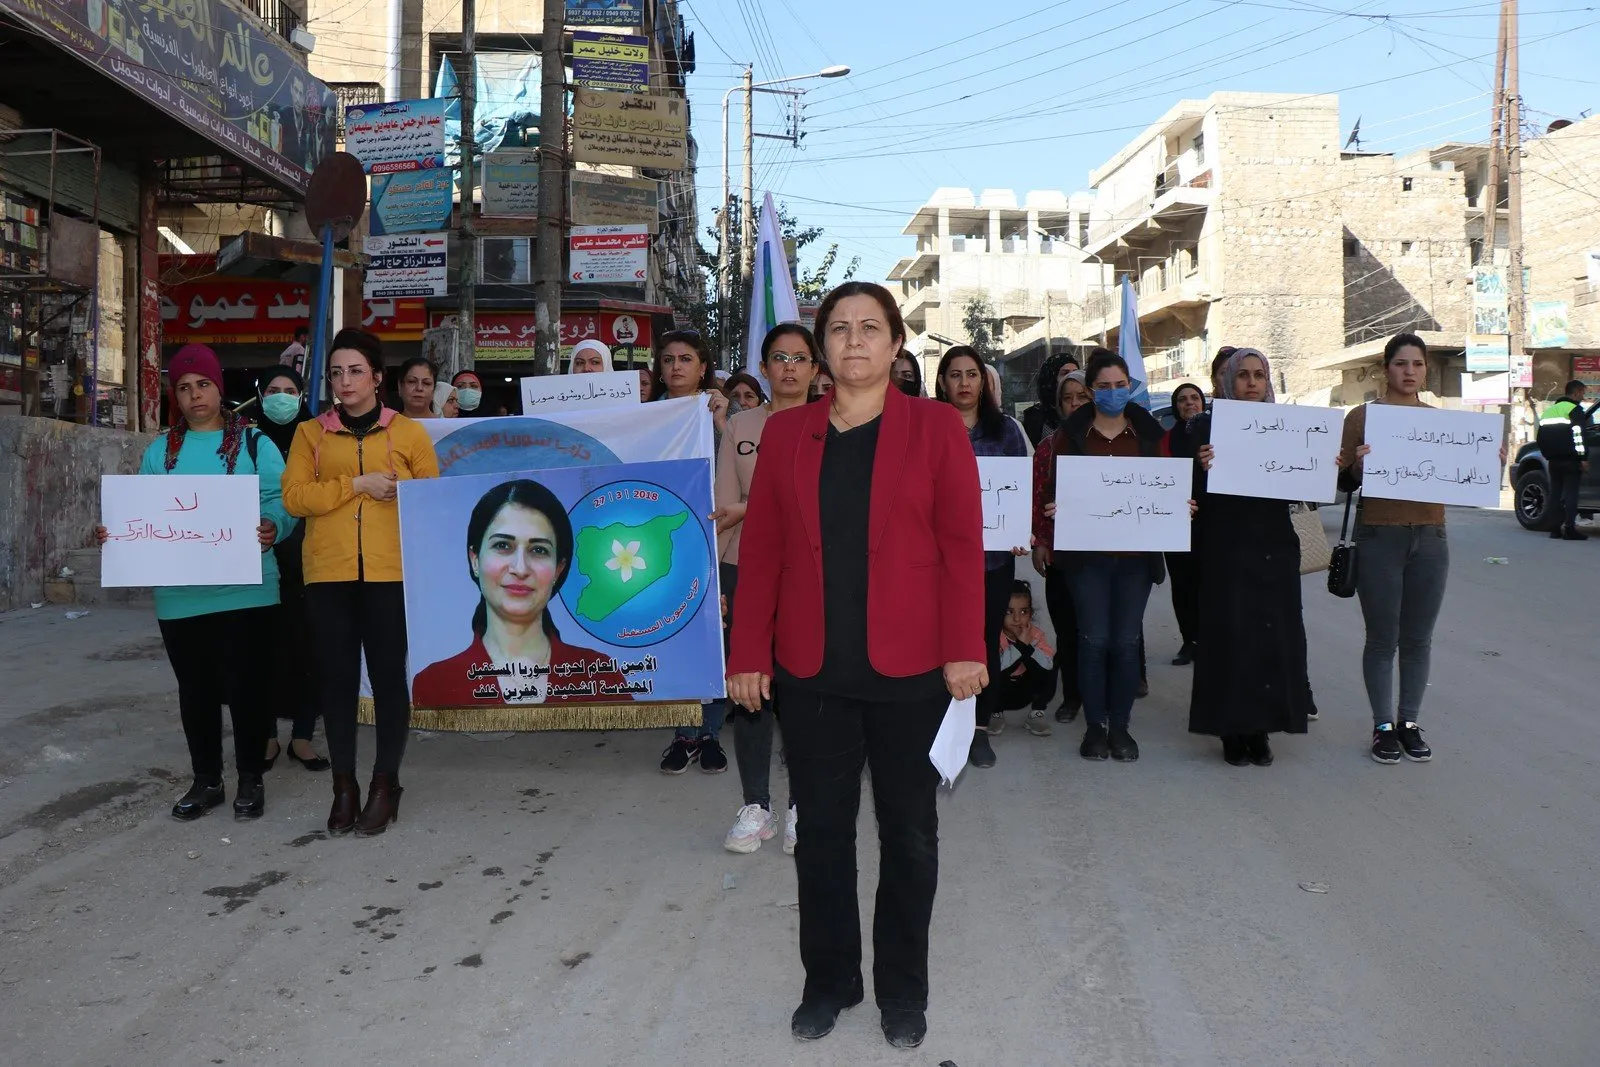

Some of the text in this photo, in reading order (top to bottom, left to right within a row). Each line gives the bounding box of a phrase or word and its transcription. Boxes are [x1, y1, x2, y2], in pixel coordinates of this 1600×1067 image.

[576, 46, 644, 60] ولات خليل عمر
[110, 56, 145, 85] تجميل
[146, 77, 171, 102] أدوات
[179, 98, 210, 126] شمسية
[379, 105, 410, 118] الدكتور
[618, 98, 656, 110] الدكتور
[400, 116, 426, 131] الرحمن
[427, 116, 442, 128] عبد
[209, 119, 238, 142] نظارات
[579, 130, 610, 143] وجراحتها
[242, 137, 261, 157] هدايا
[638, 137, 653, 146] طب
[653, 137, 661, 149] في
[662, 138, 682, 148] دكتور
[387, 237, 421, 250] الدكتور
[573, 237, 594, 250] علي
[595, 238, 622, 246] محمد
[386, 257, 402, 269] حاج
[403, 255, 426, 268] الرزاق
[427, 256, 442, 267] عبد
[187, 293, 259, 329] عمو
[476, 323, 511, 339] حميد
[517, 325, 536, 339] مو
[529, 388, 555, 405] سوريا
[582, 382, 606, 400] شمال
[1306, 420, 1329, 448] نعم
[1440, 432, 1475, 446] للسلام
[1476, 432, 1494, 455] نعم
[1101, 471, 1135, 487] انتصرنا
[593, 495, 606, 508] 27
[616, 491, 622, 500] 3
[633, 490, 659, 502] 2018
[997, 480, 1019, 506] نعم
[163, 492, 198, 512] لا
[686, 577, 700, 601] حزب
[663, 601, 688, 624] سوريا
[467, 653, 658, 682] الأمين العام لحزب سوريا المستقبل
[472, 678, 653, 702] المهندسة الشهيدة هفرين خلف
